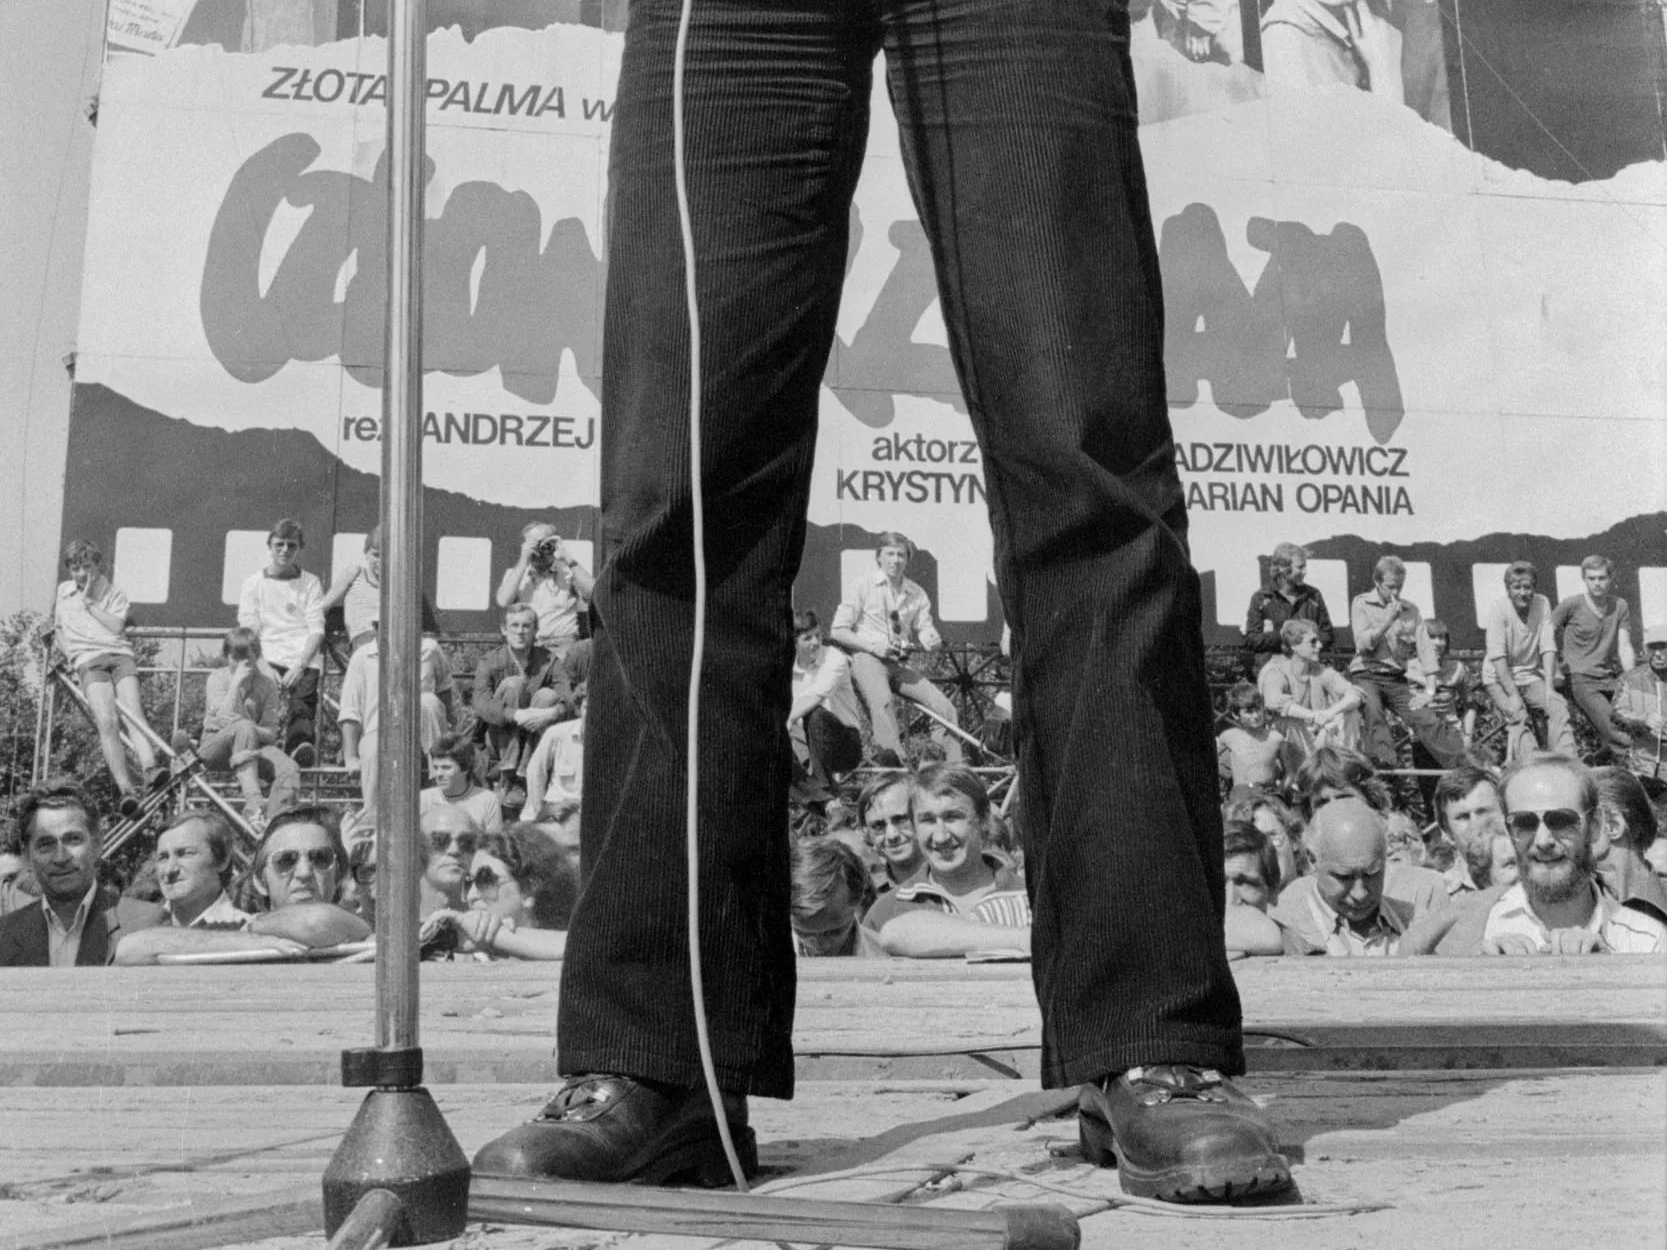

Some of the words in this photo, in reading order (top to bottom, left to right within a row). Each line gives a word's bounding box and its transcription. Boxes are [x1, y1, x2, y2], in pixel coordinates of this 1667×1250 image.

[261, 66, 387, 108] ZŁOTA
[425, 78, 566, 119] PALMA
[343, 415, 383, 442] re
[423, 411, 596, 450] ANDRZEJ
[871, 432, 980, 464] aktorz
[1174, 441, 1411, 478] ADZIWIŁOWICZ
[836, 468, 987, 504] KRYSTYN
[1182, 481, 1285, 513] ARIAN
[1296, 482, 1415, 516] OPANIA
